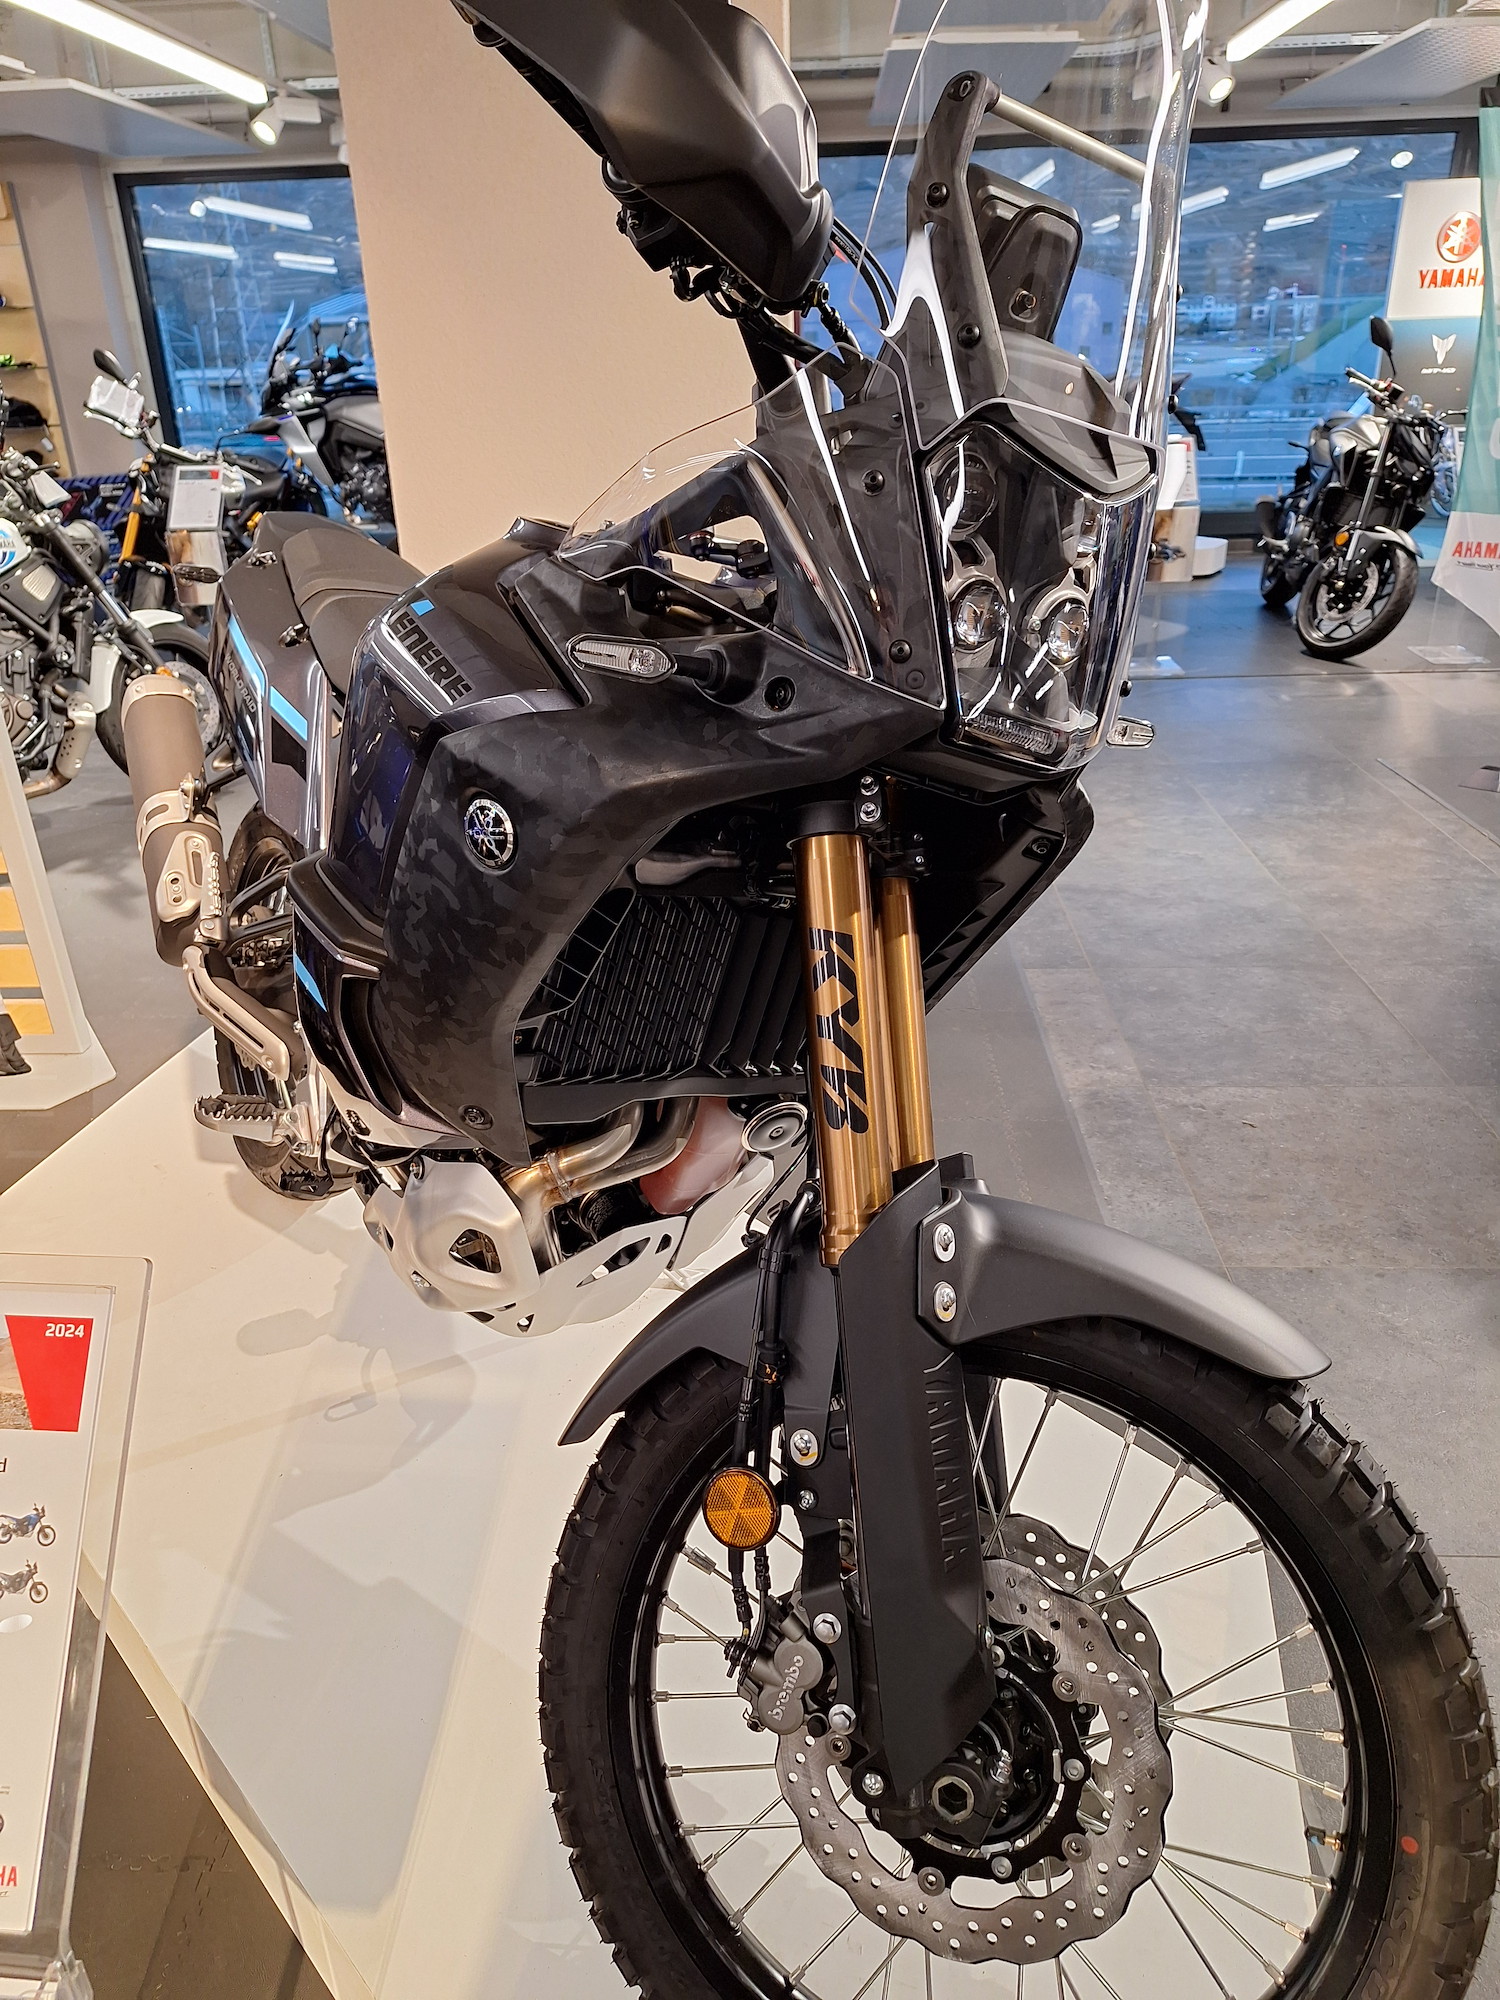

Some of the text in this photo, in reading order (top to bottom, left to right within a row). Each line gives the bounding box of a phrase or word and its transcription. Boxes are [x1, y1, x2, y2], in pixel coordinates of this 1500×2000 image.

[225, 653, 257, 713] WORLD RAID
[809, 927, 869, 1134] KYB
[45, 1323, 85, 1338] 2024
[923, 1352, 972, 1573] YAMAHA
[768, 1655, 804, 1721] brembo
